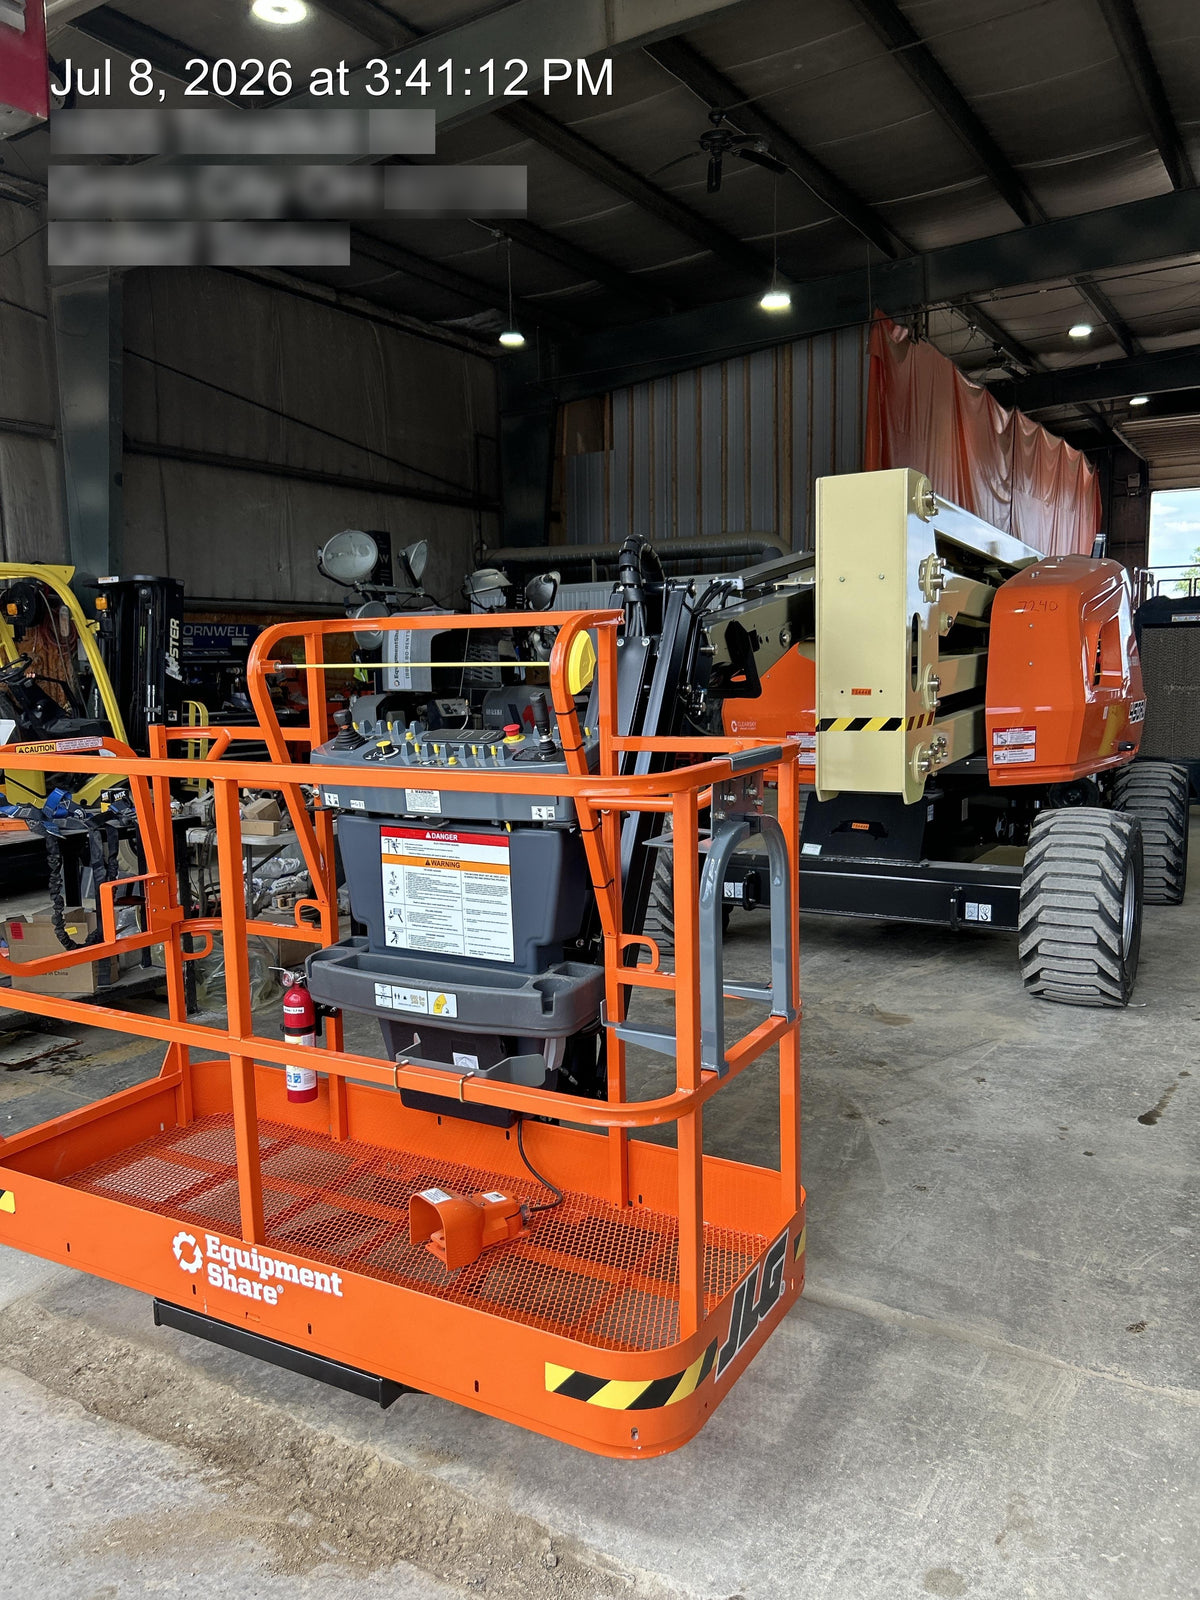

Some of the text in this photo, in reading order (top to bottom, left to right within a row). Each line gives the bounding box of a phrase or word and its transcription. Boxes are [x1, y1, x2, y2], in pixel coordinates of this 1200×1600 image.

[24, 744, 55, 754] CAUTION
[431, 832, 458, 841] DANGER
[431, 860, 460, 868] WARNING
[204, 1233, 343, 1297] Equipment
[714, 1227, 789, 1384] JLG
